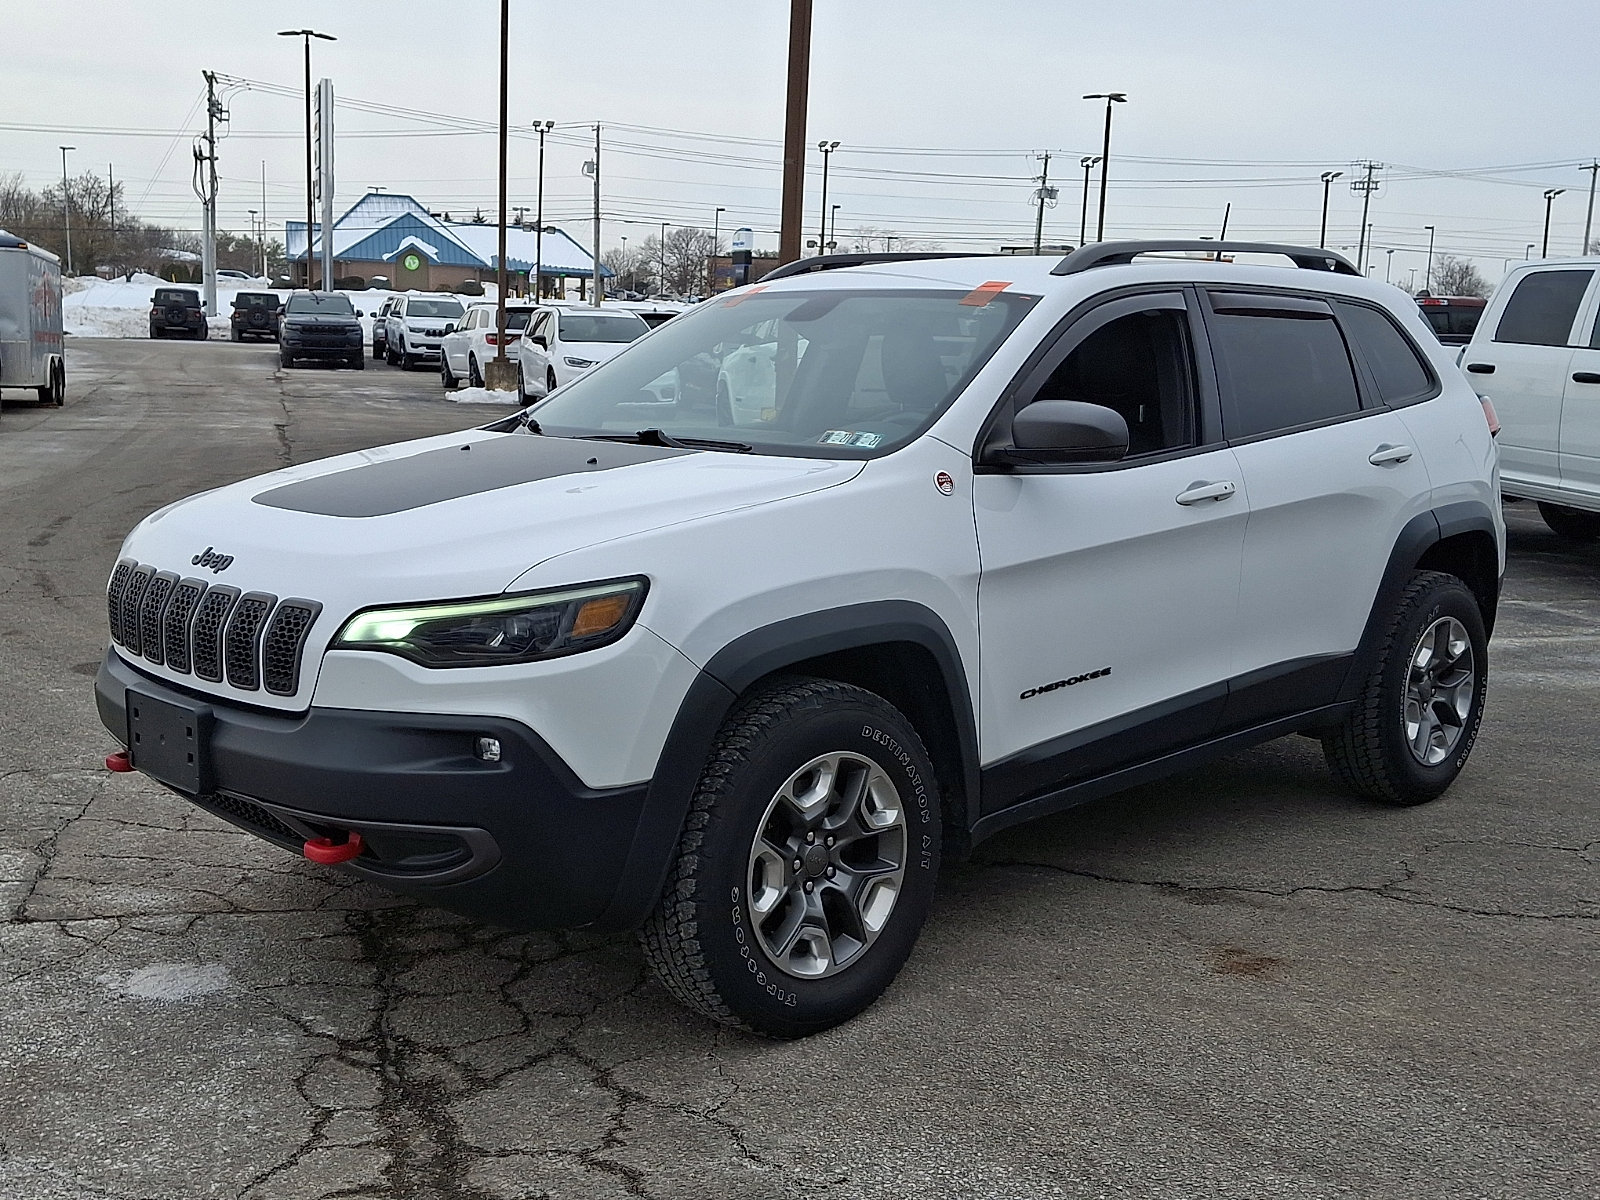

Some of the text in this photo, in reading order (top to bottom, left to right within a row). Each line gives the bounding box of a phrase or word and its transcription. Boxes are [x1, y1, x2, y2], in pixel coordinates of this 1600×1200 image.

[191, 546, 234, 575] Jeep
[1020, 667, 1112, 699] CHEROKEE
[861, 725, 932, 870] DESTINATION A/T
